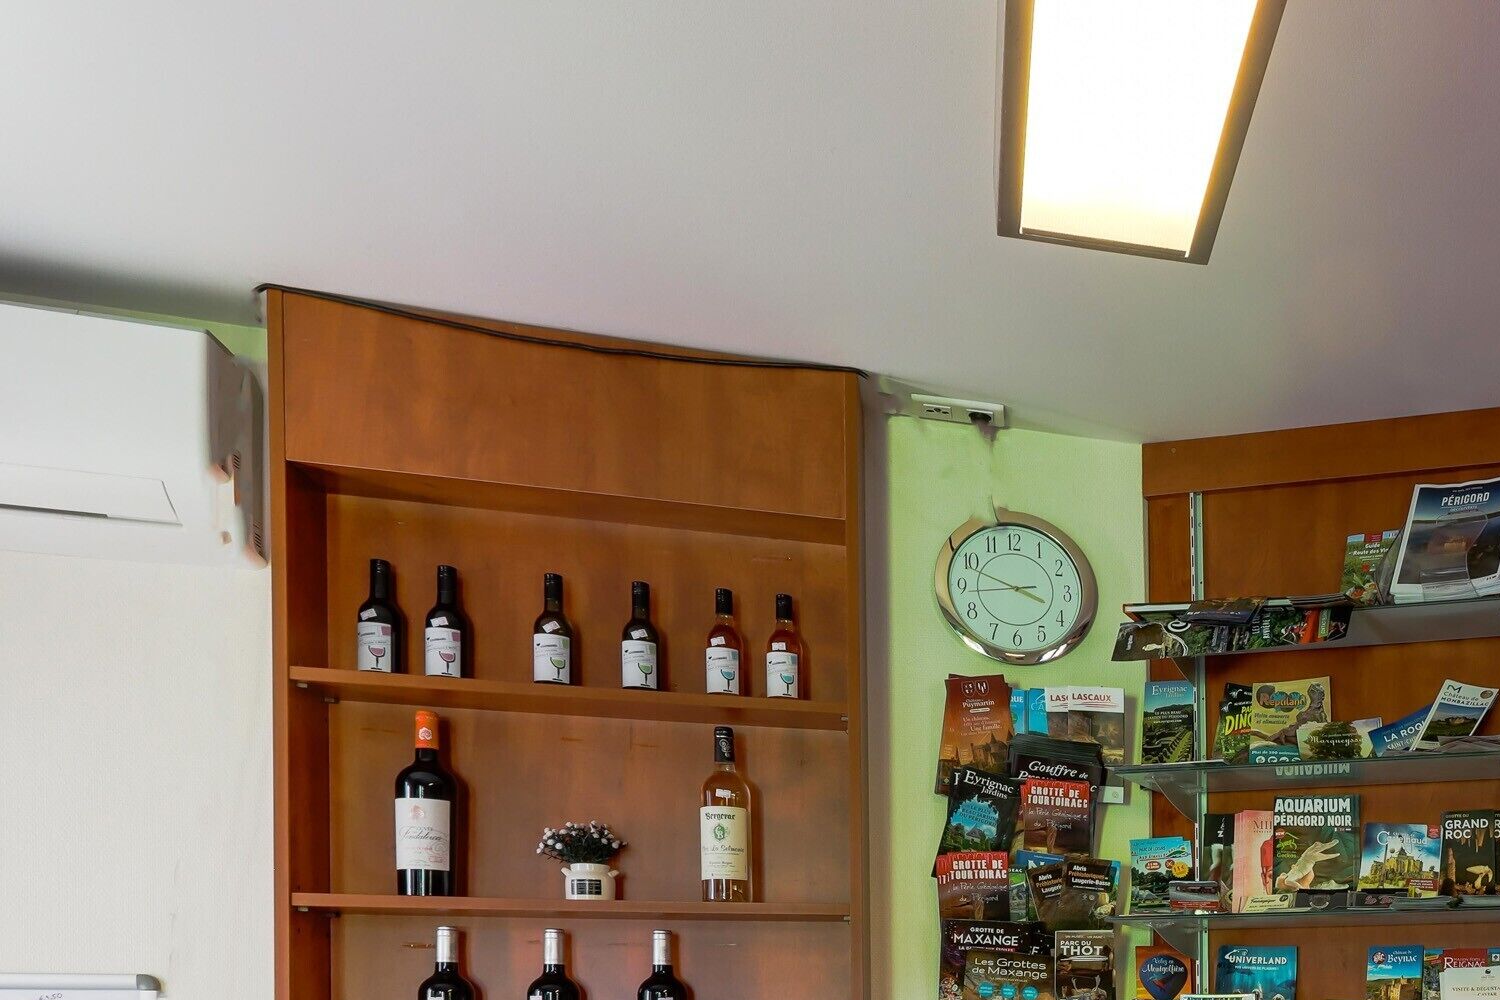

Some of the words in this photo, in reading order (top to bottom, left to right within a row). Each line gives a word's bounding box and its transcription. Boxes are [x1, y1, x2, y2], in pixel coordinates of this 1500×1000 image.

[1441, 491, 1490, 506] PÉRIGORD
[986, 536, 997, 553] 11
[1007, 533, 1021, 551] 12
[1035, 542, 1041, 559] 1
[964, 552, 979, 570] 10
[1055, 559, 1063, 577] 2
[957, 577, 967, 595] 9
[1063, 585, 1072, 602] 3
[967, 602, 978, 619] 8
[1056, 610, 1065, 627] 4
[990, 623, 999, 640] 7
[1012, 629, 1022, 647] 6
[1037, 625, 1046, 642] 5
[1072, 693, 1111, 702] LASCAUX
[1152, 685, 1188, 696] Eyrignac
[1384, 733, 1396, 743] LA
[1029, 761, 1077, 778] Gouffre
[964, 770, 1014, 793] Eyrignac
[981, 786, 1008, 800] Jardins
[1031, 786, 1064, 798] GROTTE
[1069, 789, 1080, 798] DE
[1274, 797, 1351, 813] AQUARIUM
[1274, 812, 1324, 827] PÉRIGORD
[1328, 814, 1352, 827] NOIR
[1445, 818, 1488, 829] GRAND
[1445, 829, 1472, 840] ROC
[953, 860, 987, 870] GROTTE
[992, 860, 1003, 869] DE
[950, 869, 1007, 880] TOURTOIRAC
[953, 933, 1019, 947] MAXANGE
[1060, 946, 1103, 957] THOT
[974, 957, 994, 966] Les
[997, 958, 1046, 970] Grottes
[1229, 955, 1287, 965] UNIVERLAND
[972, 966, 986, 974] de
[988, 966, 1048, 980] Maxange
